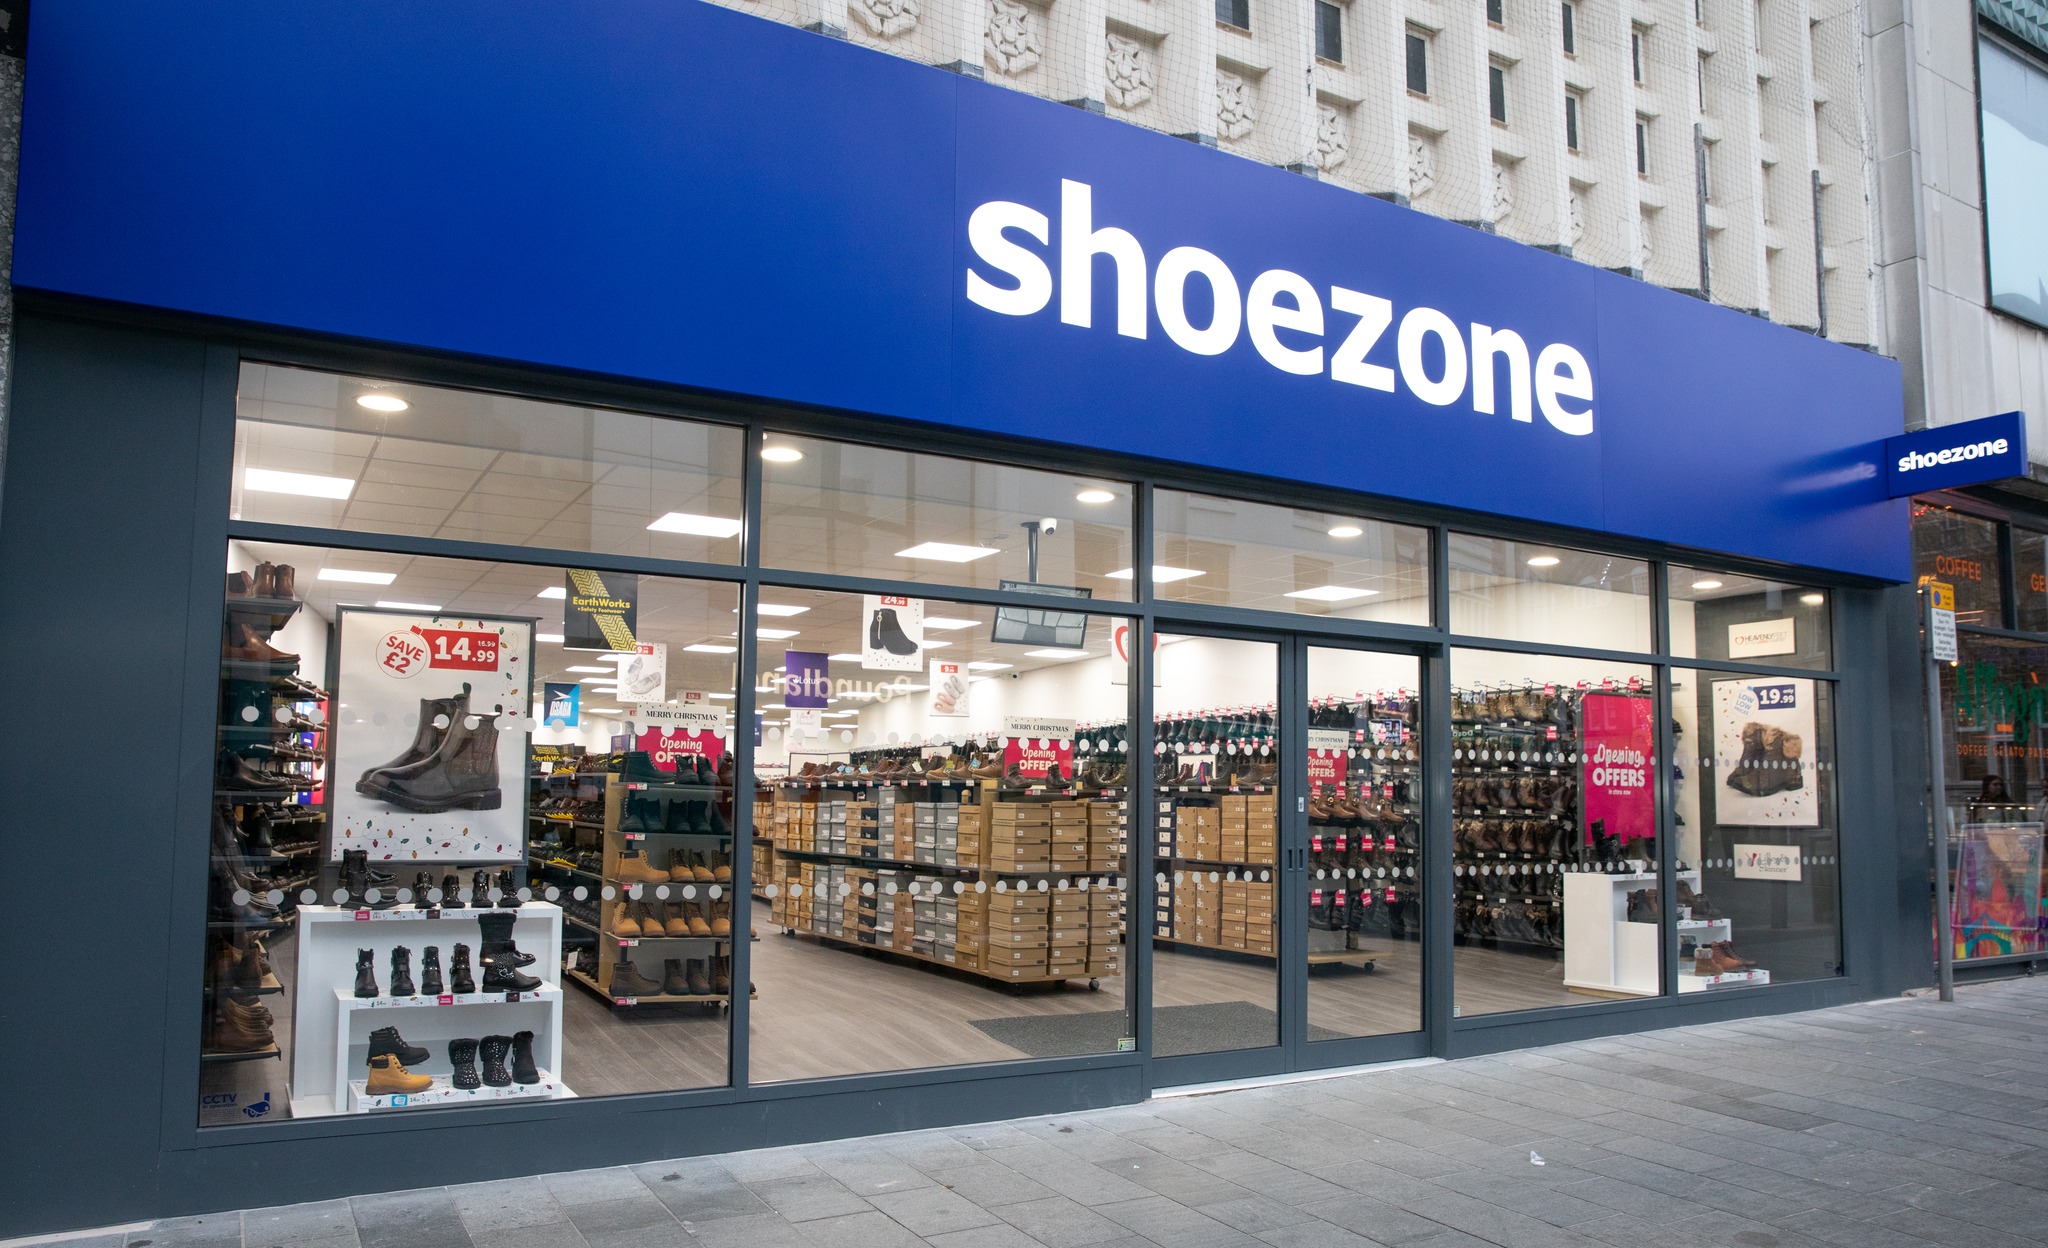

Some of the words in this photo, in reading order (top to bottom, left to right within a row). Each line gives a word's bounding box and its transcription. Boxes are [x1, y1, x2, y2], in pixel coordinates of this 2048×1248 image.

[967, 178, 1594, 436] shoezone
[1898, 438, 2008, 472] shoezone
[1935, 555, 1982, 581] COFFEE
[572, 596, 630, 609] EarthWorks
[386, 636, 424, 661] SAVE
[434, 636, 496, 663] 14.99
[383, 651, 410, 674] £2
[799, 677, 820, 685] Lotus
[1738, 693, 1754, 703] LOW
[1760, 689, 1794, 705] 19.99
[1735, 701, 1752, 710] LOW
[646, 710, 673, 718] MERRY
[674, 712, 718, 720] CHRISTMAS
[660, 736, 702, 752] Opening
[1957, 744, 1988, 756] COFFEE
[1022, 748, 1056, 760] Opening
[1596, 743, 1641, 768] Opening
[1592, 767, 1645, 787] OFFERS
[203, 1093, 237, 1104] CCTV
